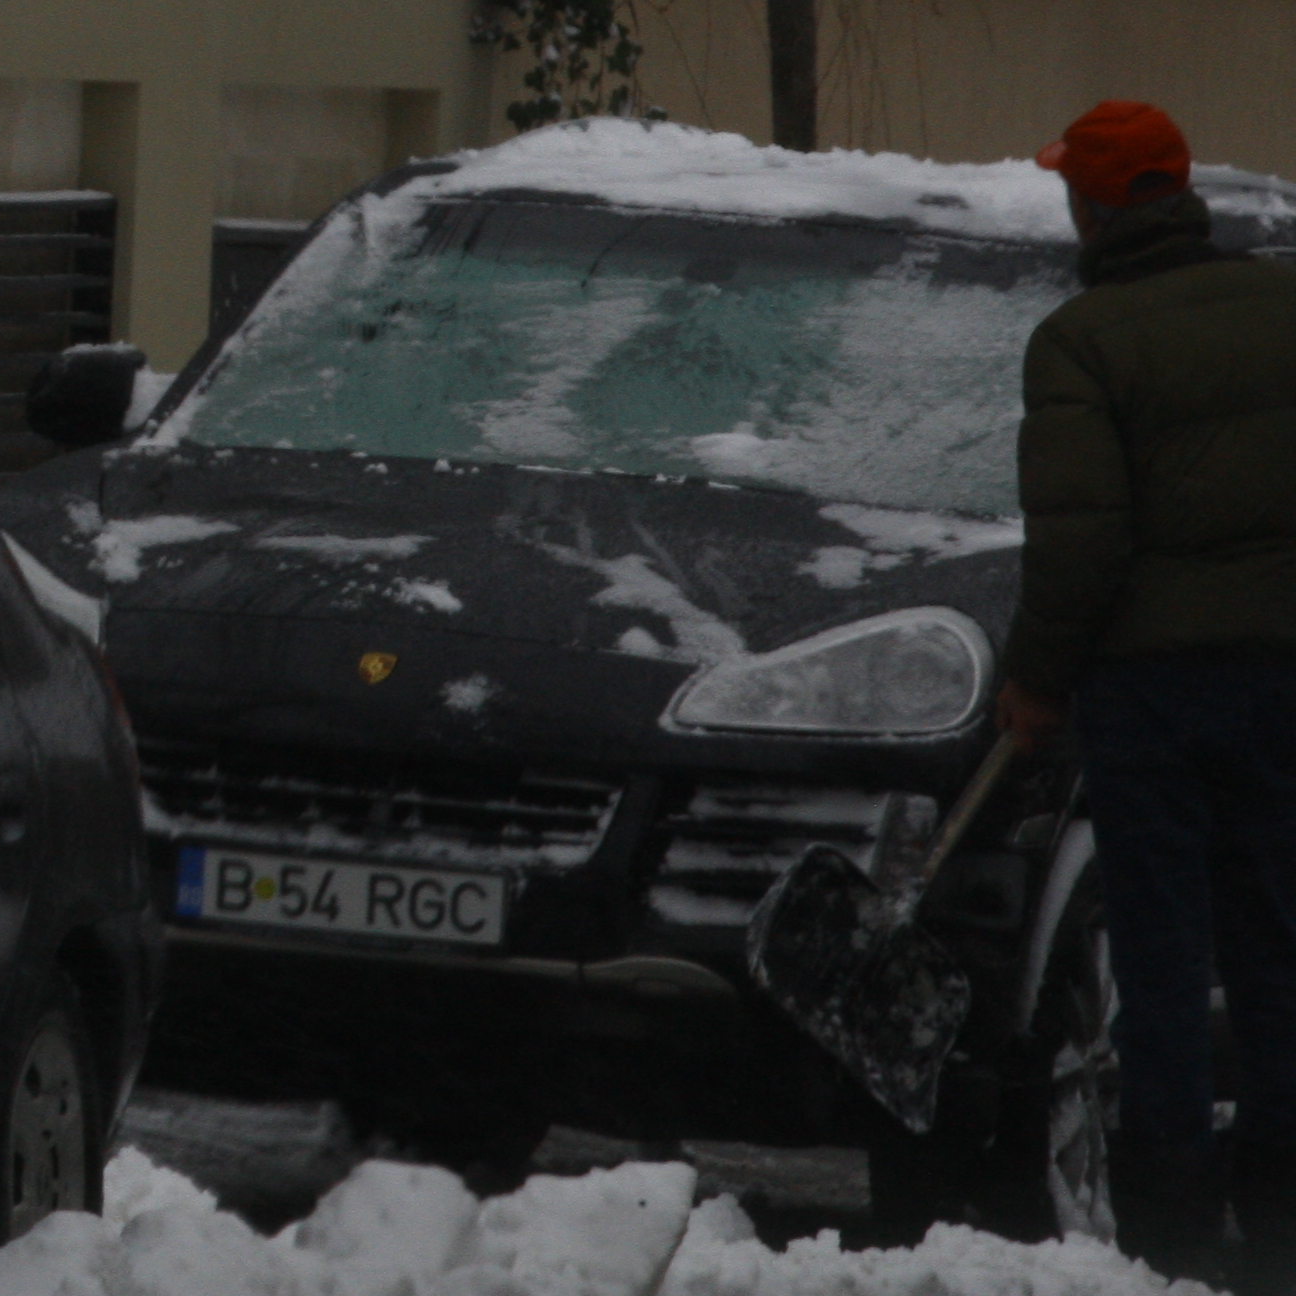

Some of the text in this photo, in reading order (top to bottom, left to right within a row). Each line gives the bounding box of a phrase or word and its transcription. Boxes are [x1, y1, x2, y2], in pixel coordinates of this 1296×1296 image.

[216, 859, 487, 934] B 54 RGC
